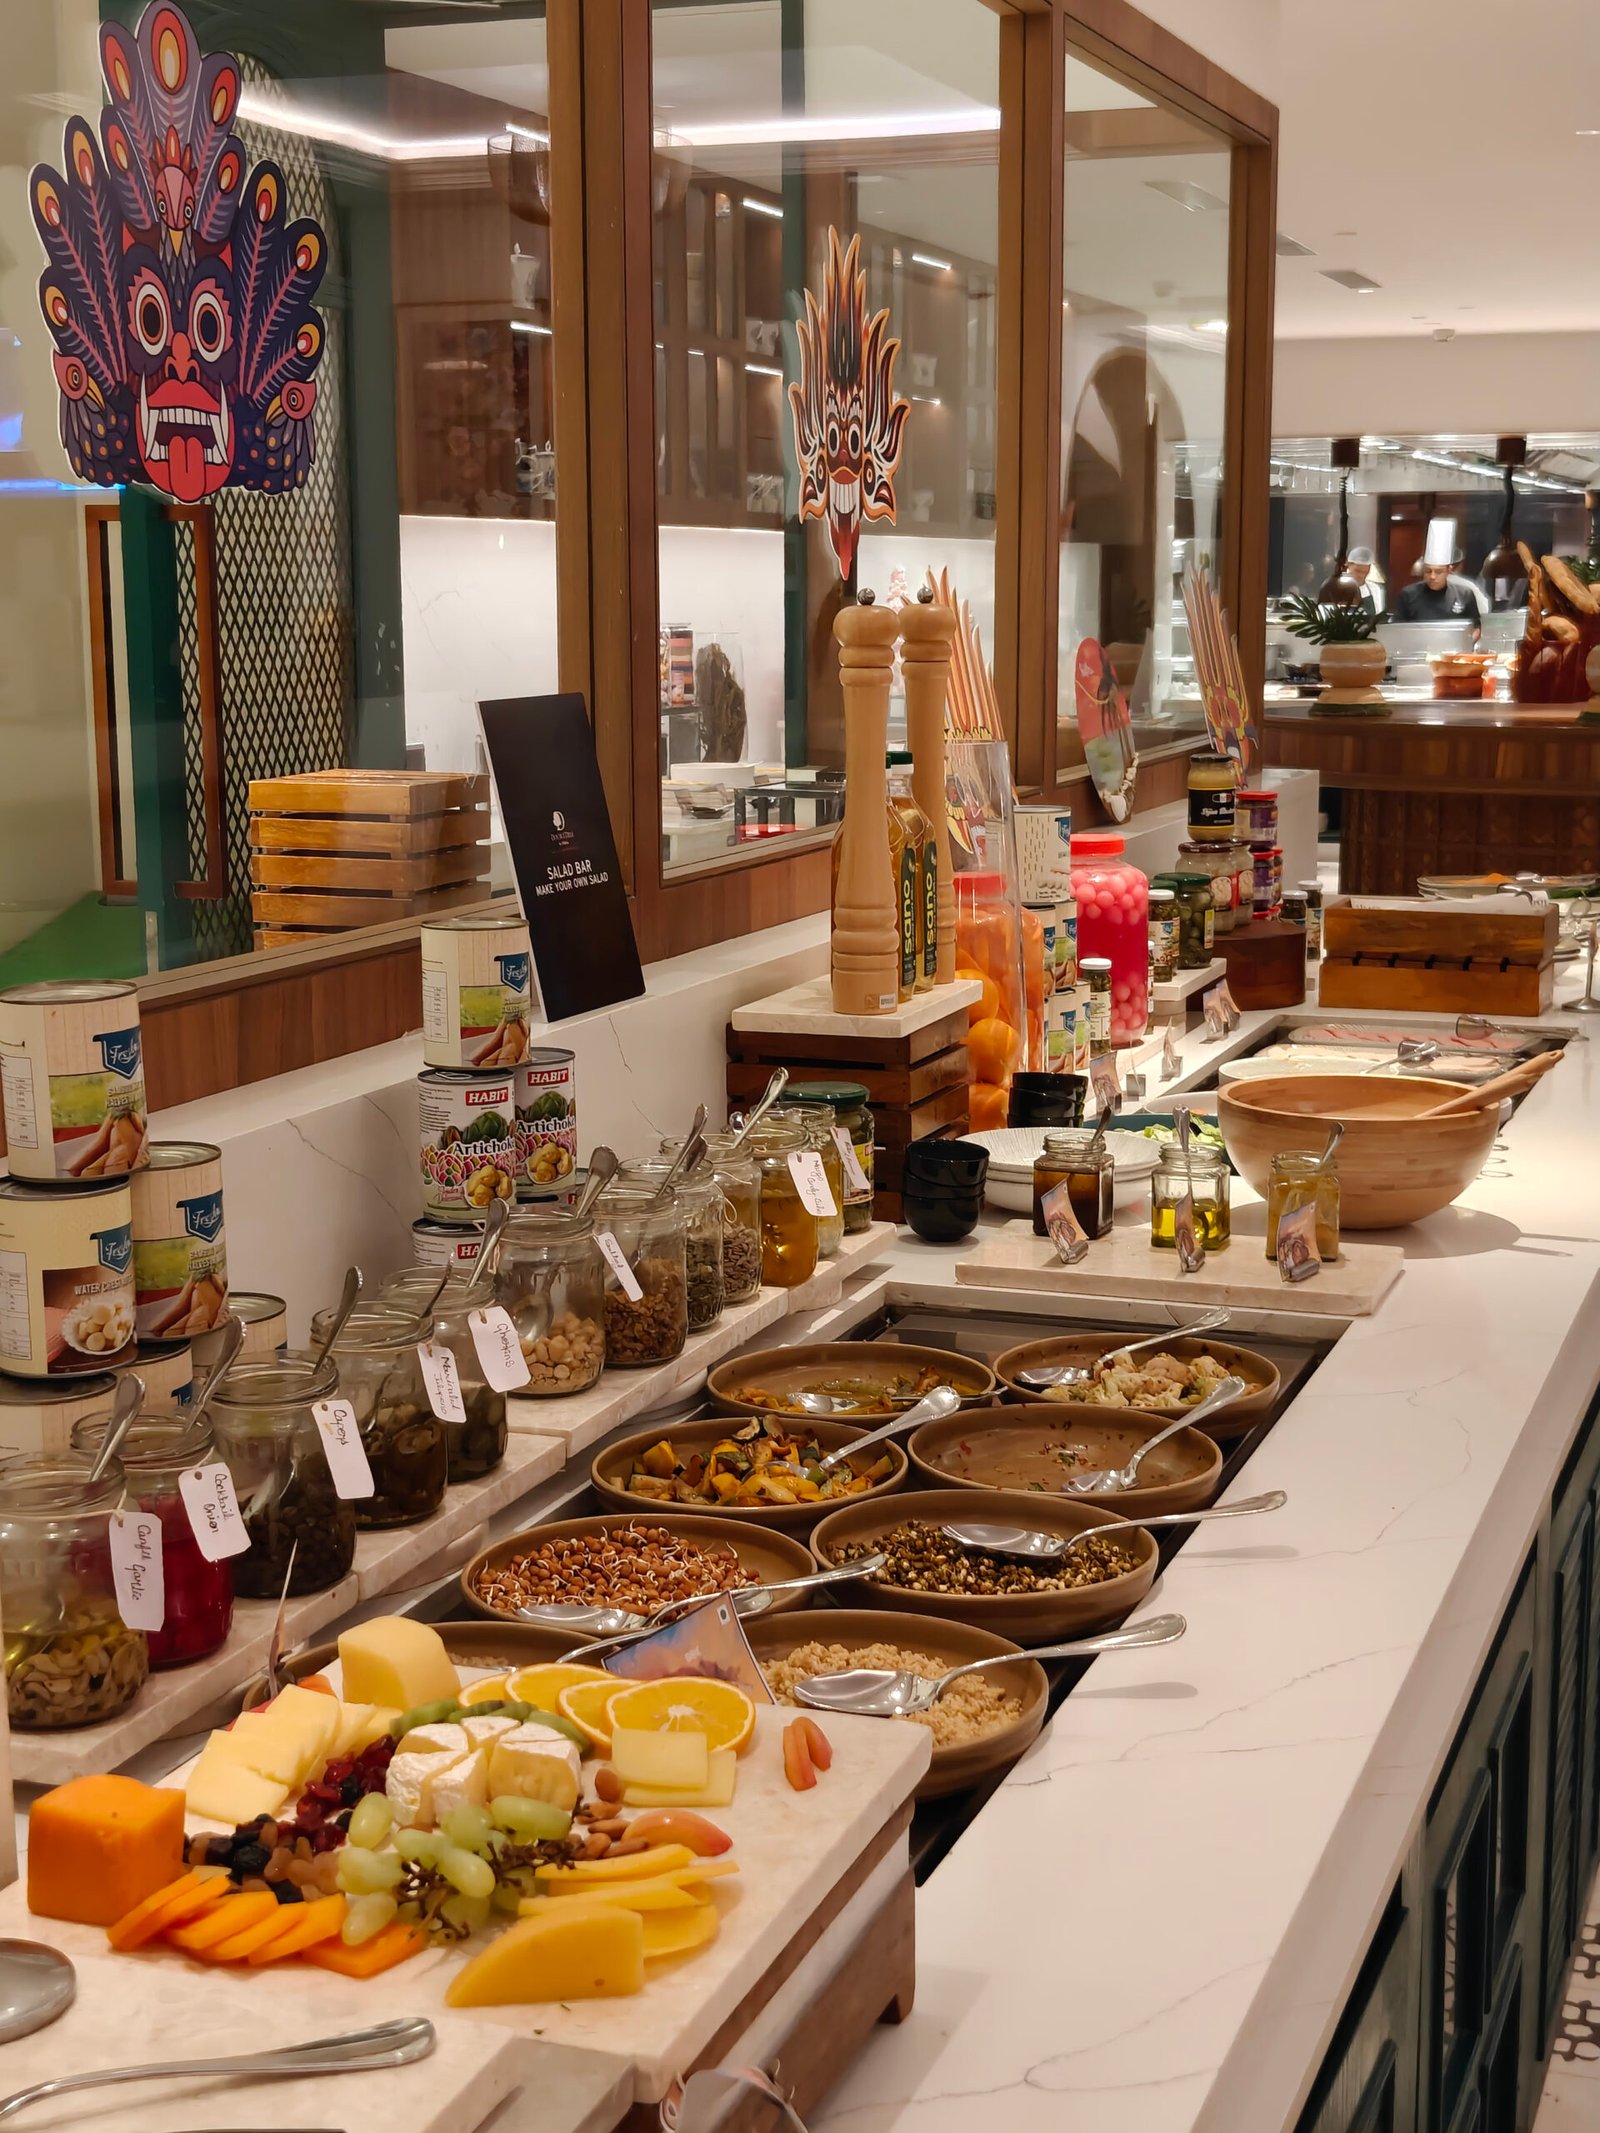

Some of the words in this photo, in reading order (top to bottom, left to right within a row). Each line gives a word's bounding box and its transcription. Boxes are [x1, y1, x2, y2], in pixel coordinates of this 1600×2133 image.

[546, 862, 574, 880] SALAD
[574, 859, 593, 875] BAR
[535, 883, 554, 897] MAKE
[554, 879, 573, 892] YOUR
[573, 876, 589, 888] OWN
[589, 871, 609, 885] SALAD
[903, 879, 912, 955] sano
[926, 872, 934, 945] sano
[530, 1069, 568, 1084] HABIT
[468, 1089, 508, 1104] HABIT
[75, 1282, 101, 1296] WATER
[214, 1473, 235, 1522] Cocktail
[203, 1503, 219, 1533] Onion
[125, 1563, 145, 1601] Garlic
